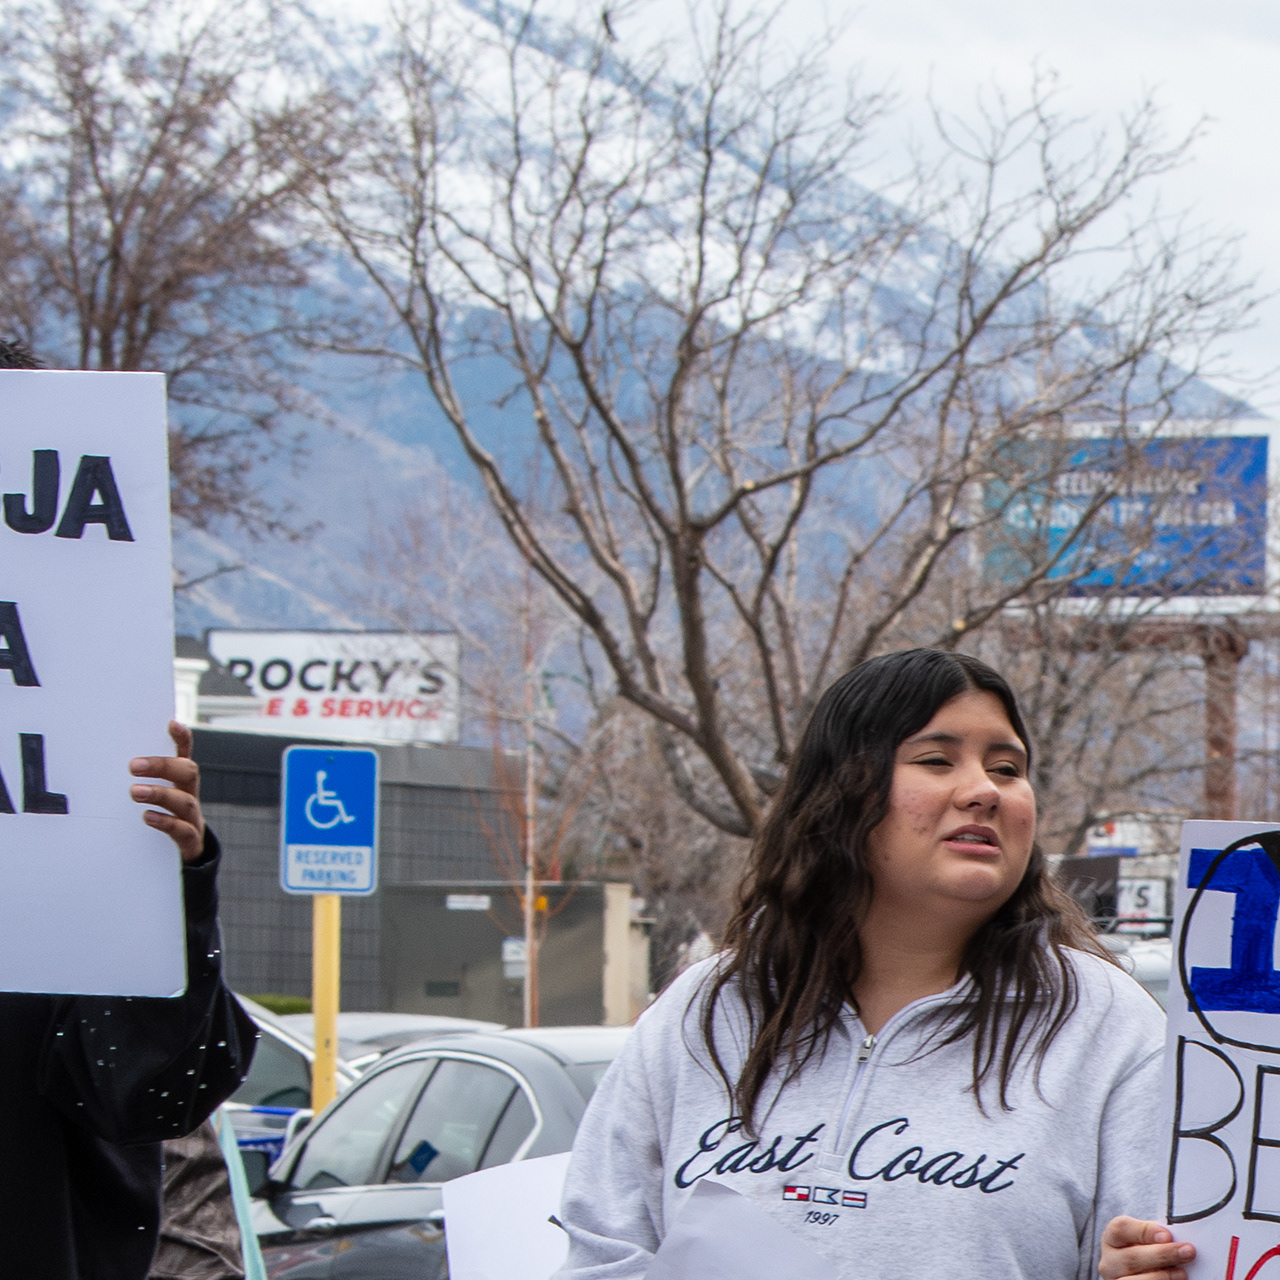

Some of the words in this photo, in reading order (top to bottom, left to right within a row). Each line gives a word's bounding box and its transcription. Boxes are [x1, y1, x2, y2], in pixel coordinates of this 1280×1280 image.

[0, 732, 70, 814] L
[675, 1115, 827, 1189] East
[847, 1117, 1026, 1194] Coast
[803, 1210, 841, 1227] 1997
